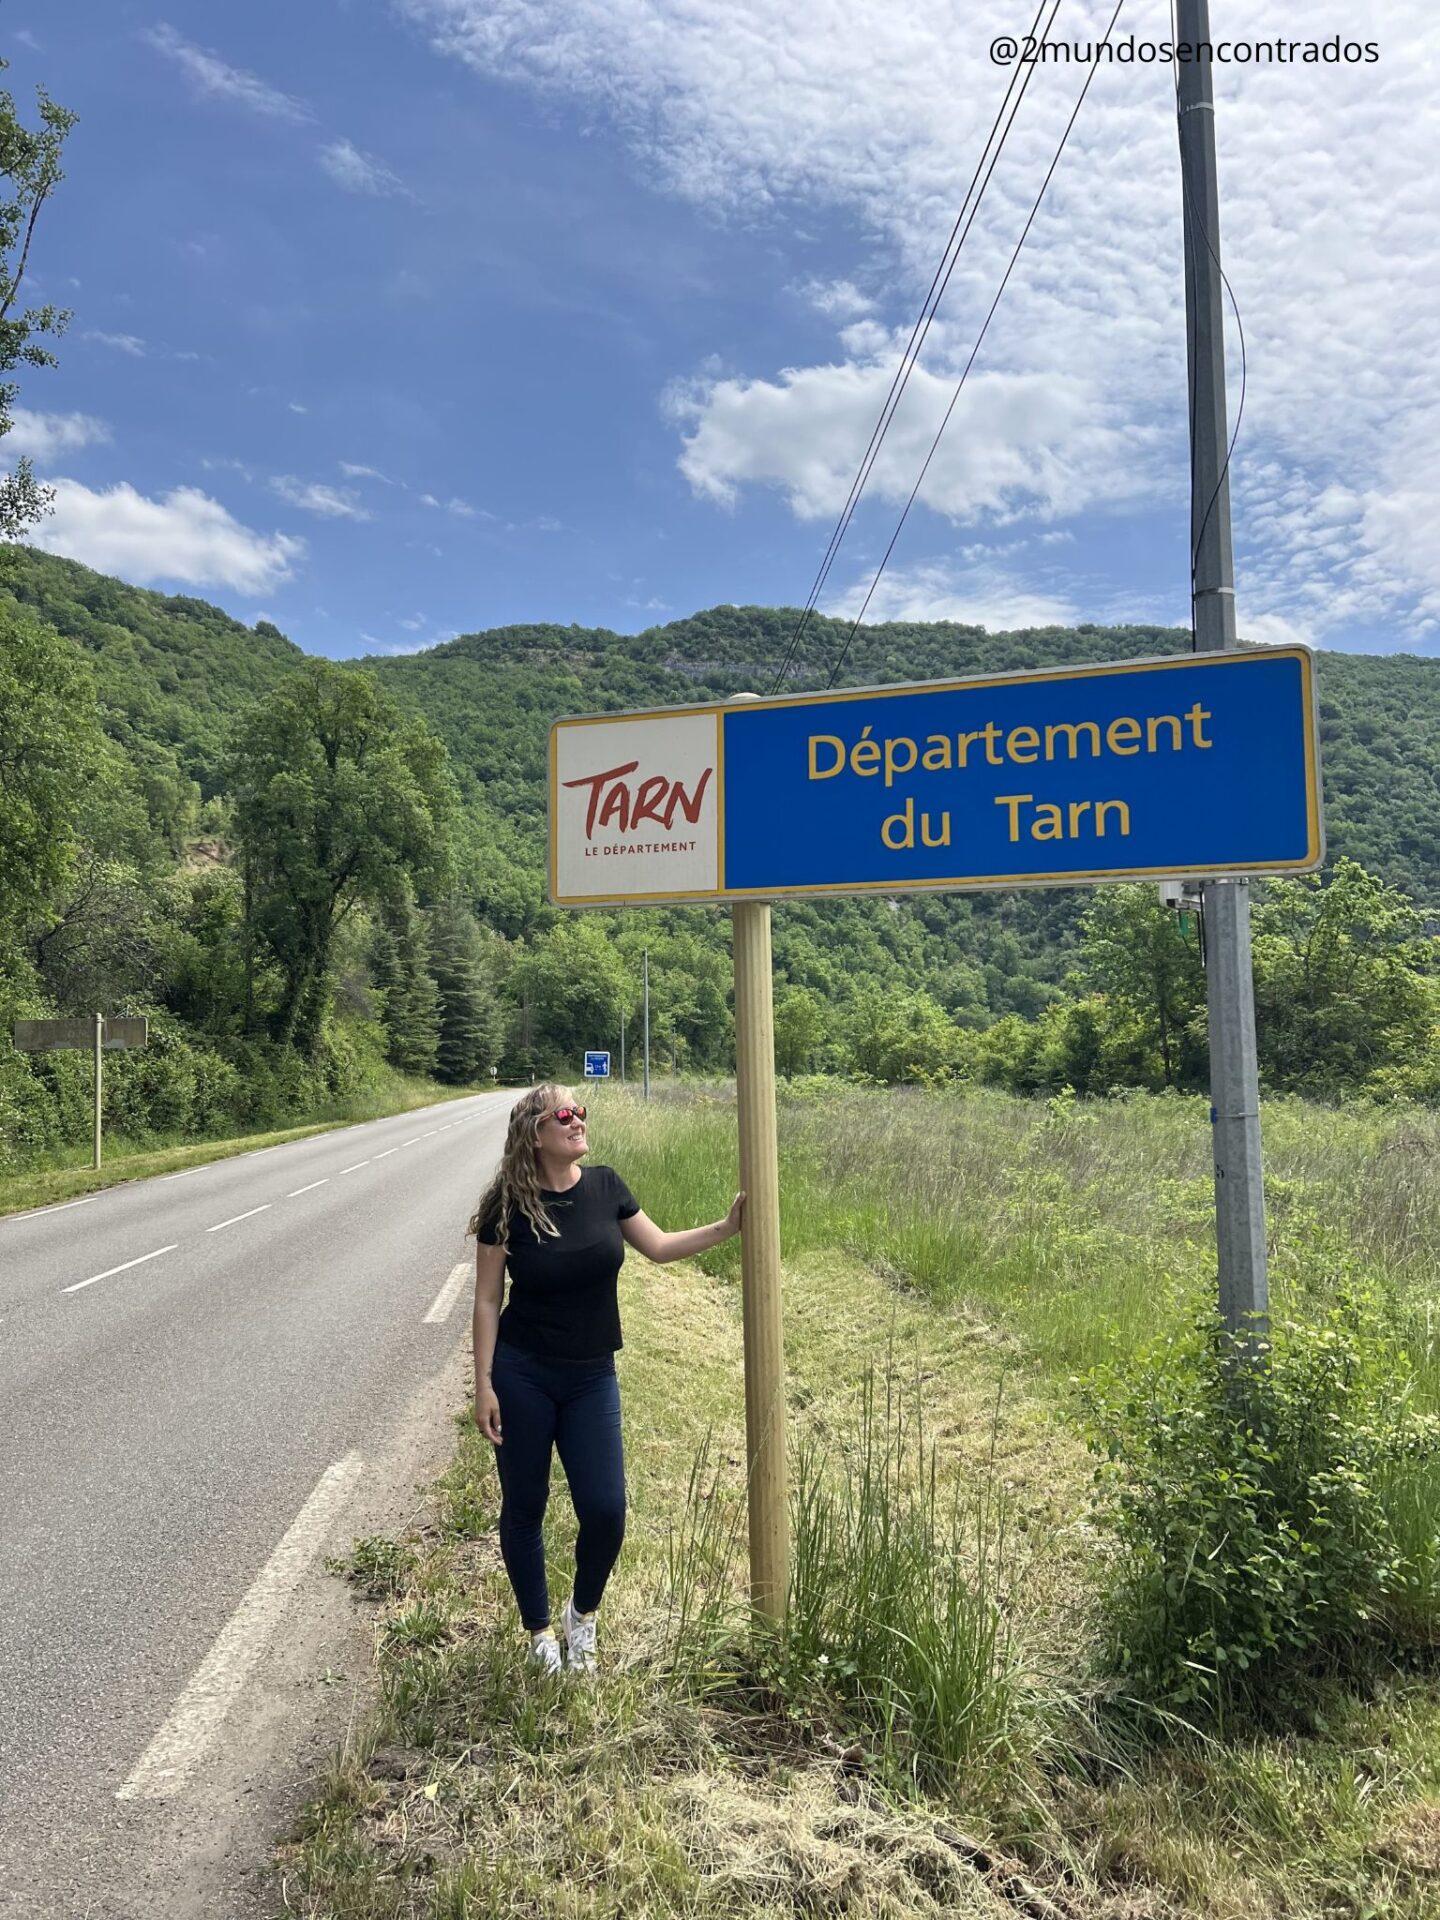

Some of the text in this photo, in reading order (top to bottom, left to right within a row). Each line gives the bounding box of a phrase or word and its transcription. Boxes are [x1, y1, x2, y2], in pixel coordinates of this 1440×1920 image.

[808, 703, 1213, 787] Département
[562, 761, 713, 841] TARN
[881, 794, 1130, 850] du Tarn
[585, 841, 697, 857] LE DÉPARTEMENT
